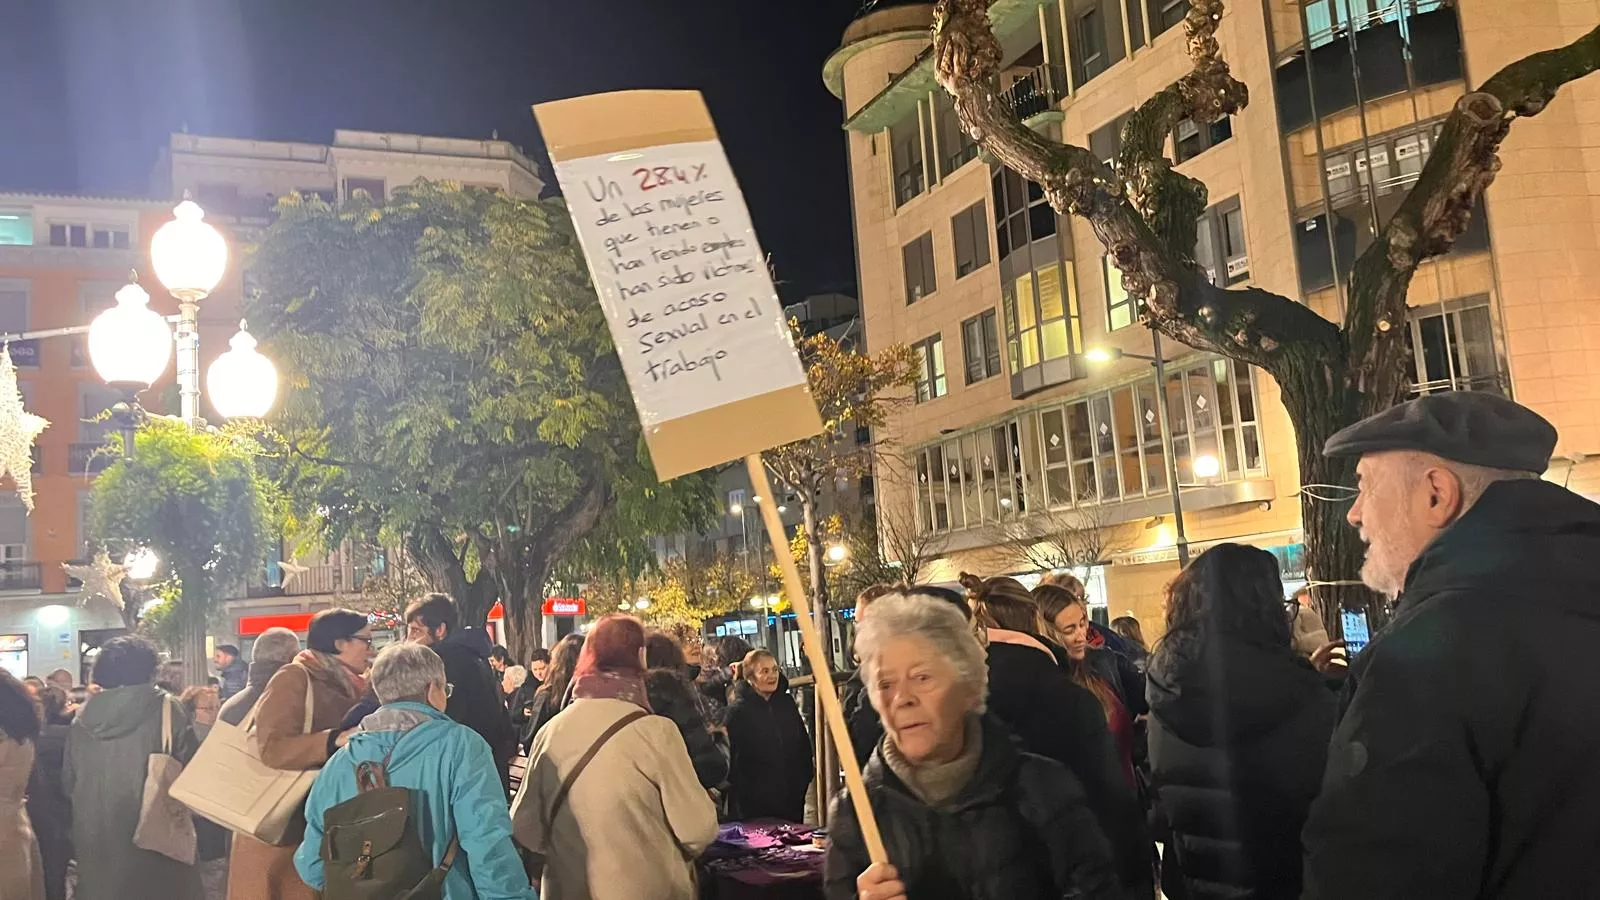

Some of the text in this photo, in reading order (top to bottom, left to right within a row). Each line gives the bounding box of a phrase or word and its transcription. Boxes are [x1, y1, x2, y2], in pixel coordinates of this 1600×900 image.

[583, 175, 623, 202] Un
[595, 190, 725, 226] de las mujeres
[603, 216, 721, 258] que tienen o
[608, 258, 645, 275] han
[649, 238, 697, 264] tenido
[616, 281, 653, 301] han
[657, 264, 696, 288] sido
[626, 307, 655, 329] de
[717, 312, 740, 326] en
[744, 297, 763, 320] el
[644, 350, 729, 382] trabajo
